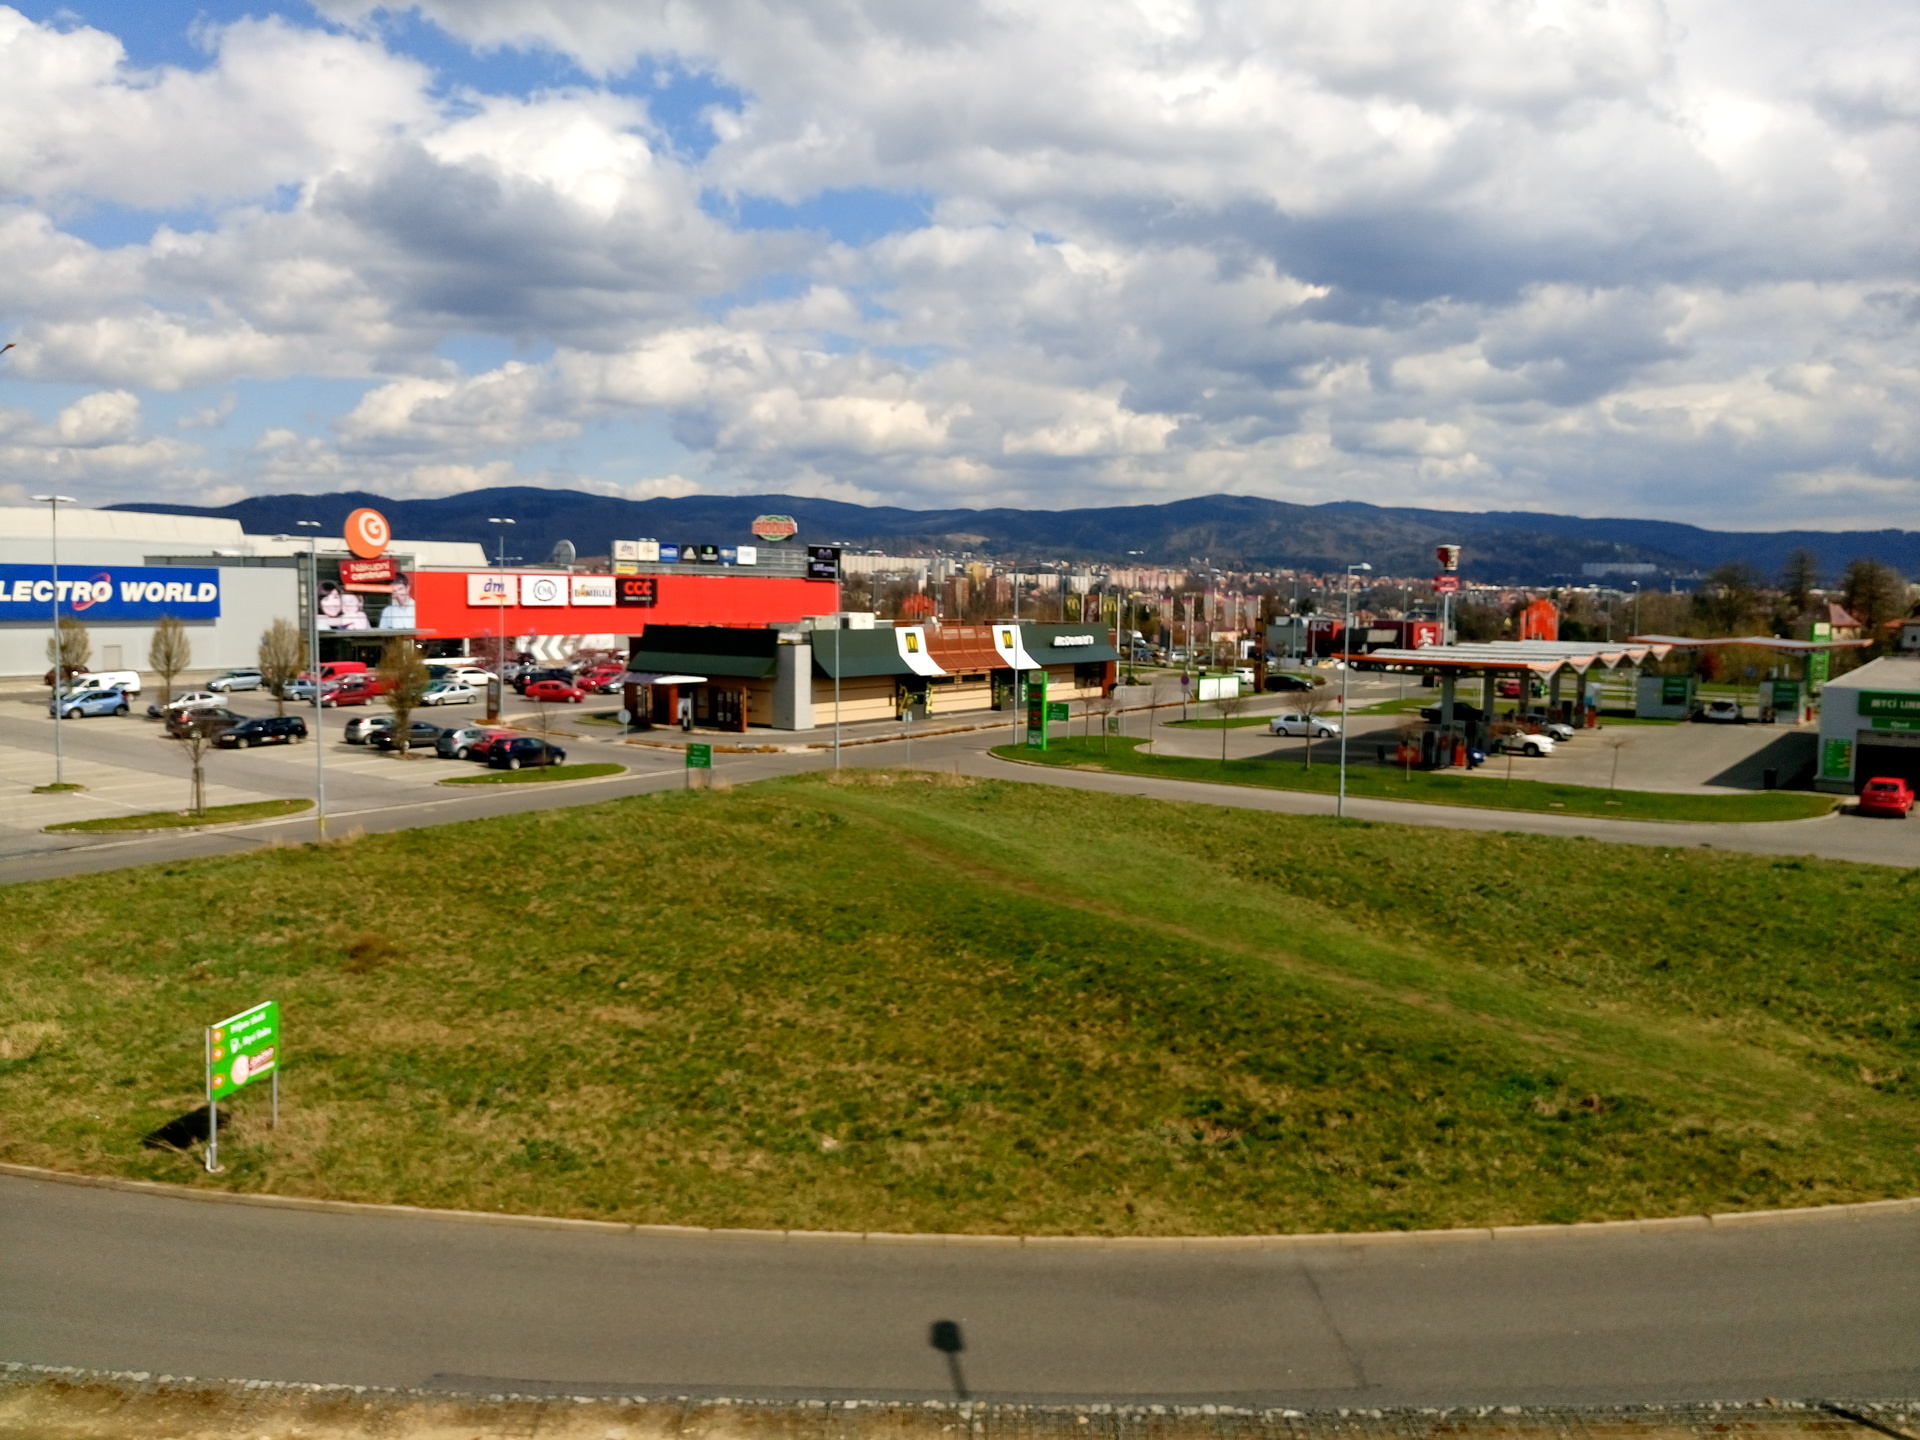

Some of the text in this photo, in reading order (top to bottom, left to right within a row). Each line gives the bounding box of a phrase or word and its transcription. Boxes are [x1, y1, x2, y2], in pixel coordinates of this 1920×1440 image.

[351, 570, 391, 581] centrum
[120, 581, 218, 603] WORLD
[483, 578, 505, 593] dm
[623, 581, 653, 595] CCC
